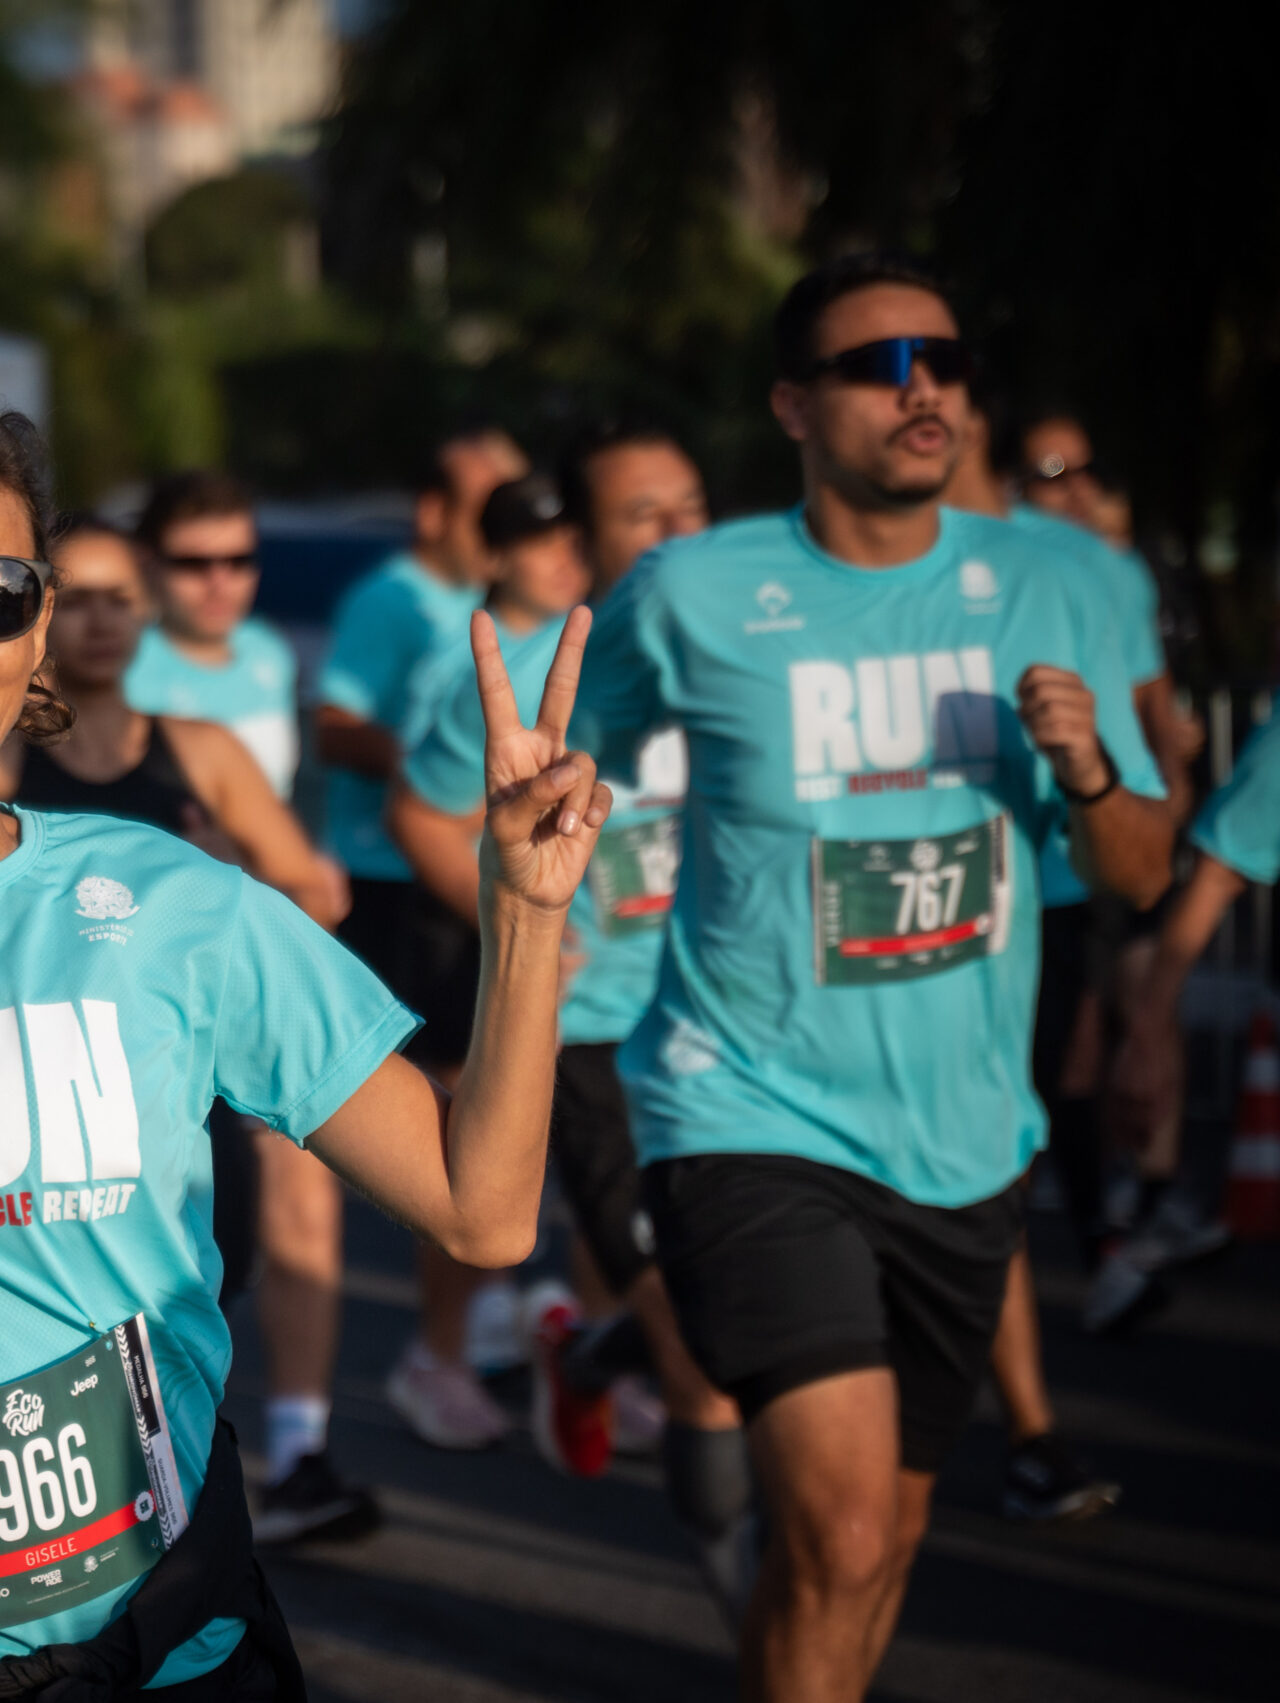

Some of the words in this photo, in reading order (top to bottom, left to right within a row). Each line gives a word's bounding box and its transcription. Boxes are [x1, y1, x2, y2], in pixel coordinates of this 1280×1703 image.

[788, 645, 998, 774] RUN
[889, 862, 967, 936] 767
[43, 1184, 137, 1225] REPEAT
[133, 1355, 145, 1385] MEDALHA
[70, 1374, 99, 1397] Jeep
[25, 1537, 78, 1567] GISELE
[30, 1569, 62, 1585] POWER
